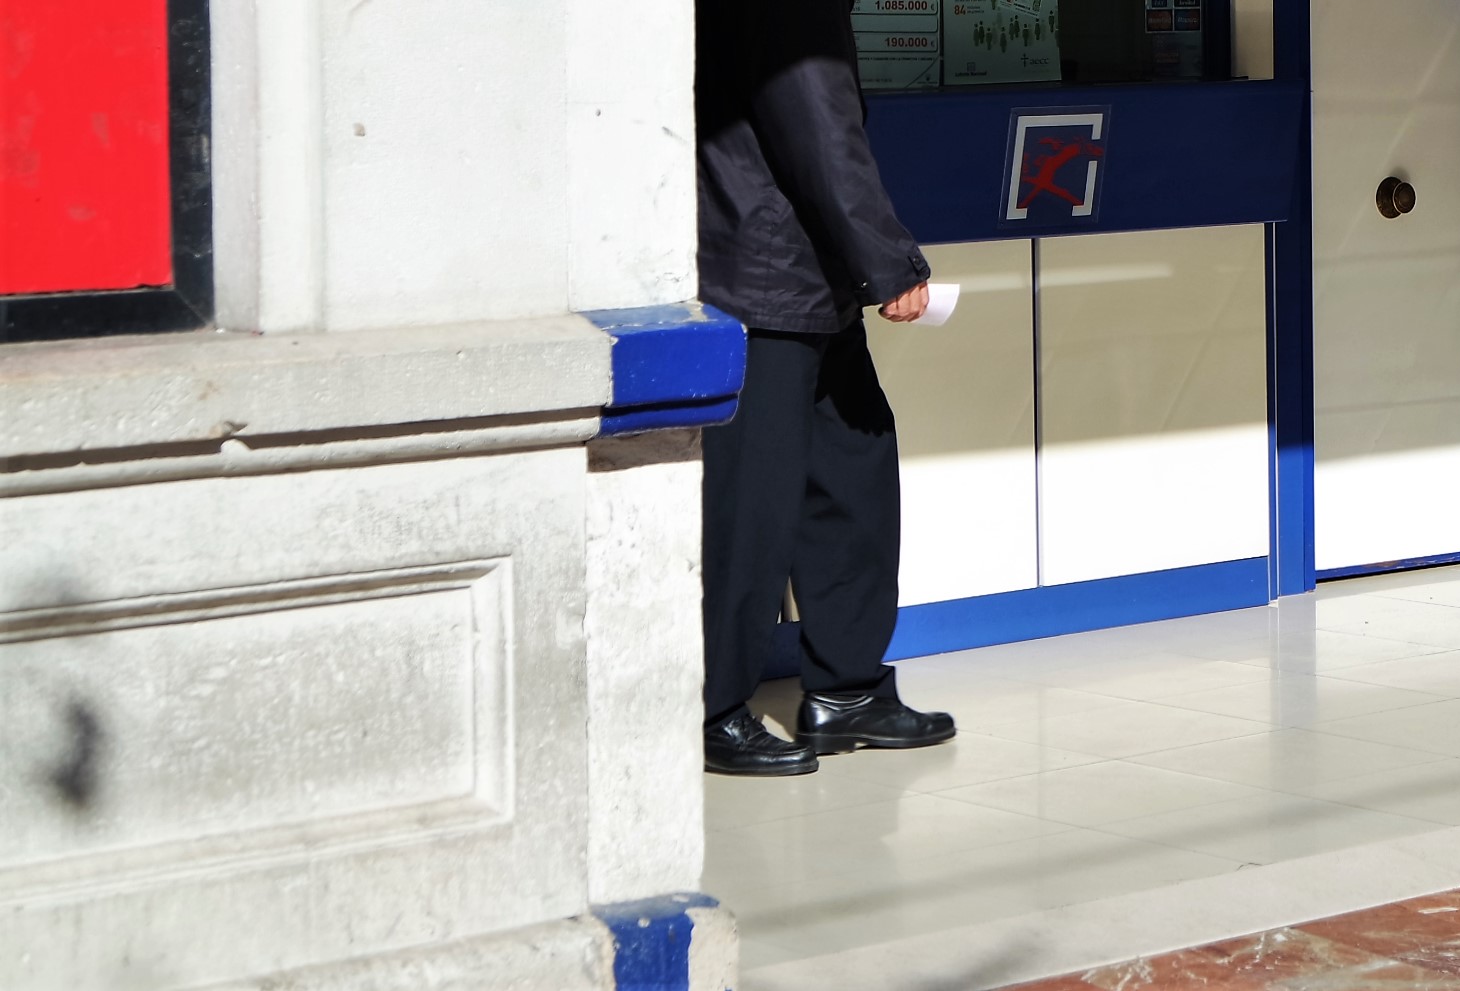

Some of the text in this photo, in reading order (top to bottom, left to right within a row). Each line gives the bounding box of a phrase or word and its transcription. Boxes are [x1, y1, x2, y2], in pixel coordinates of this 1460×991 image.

[875, 0, 928, 11] 1.085.000
[954, 5, 967, 16] 84
[885, 38, 928, 48] 190.000
